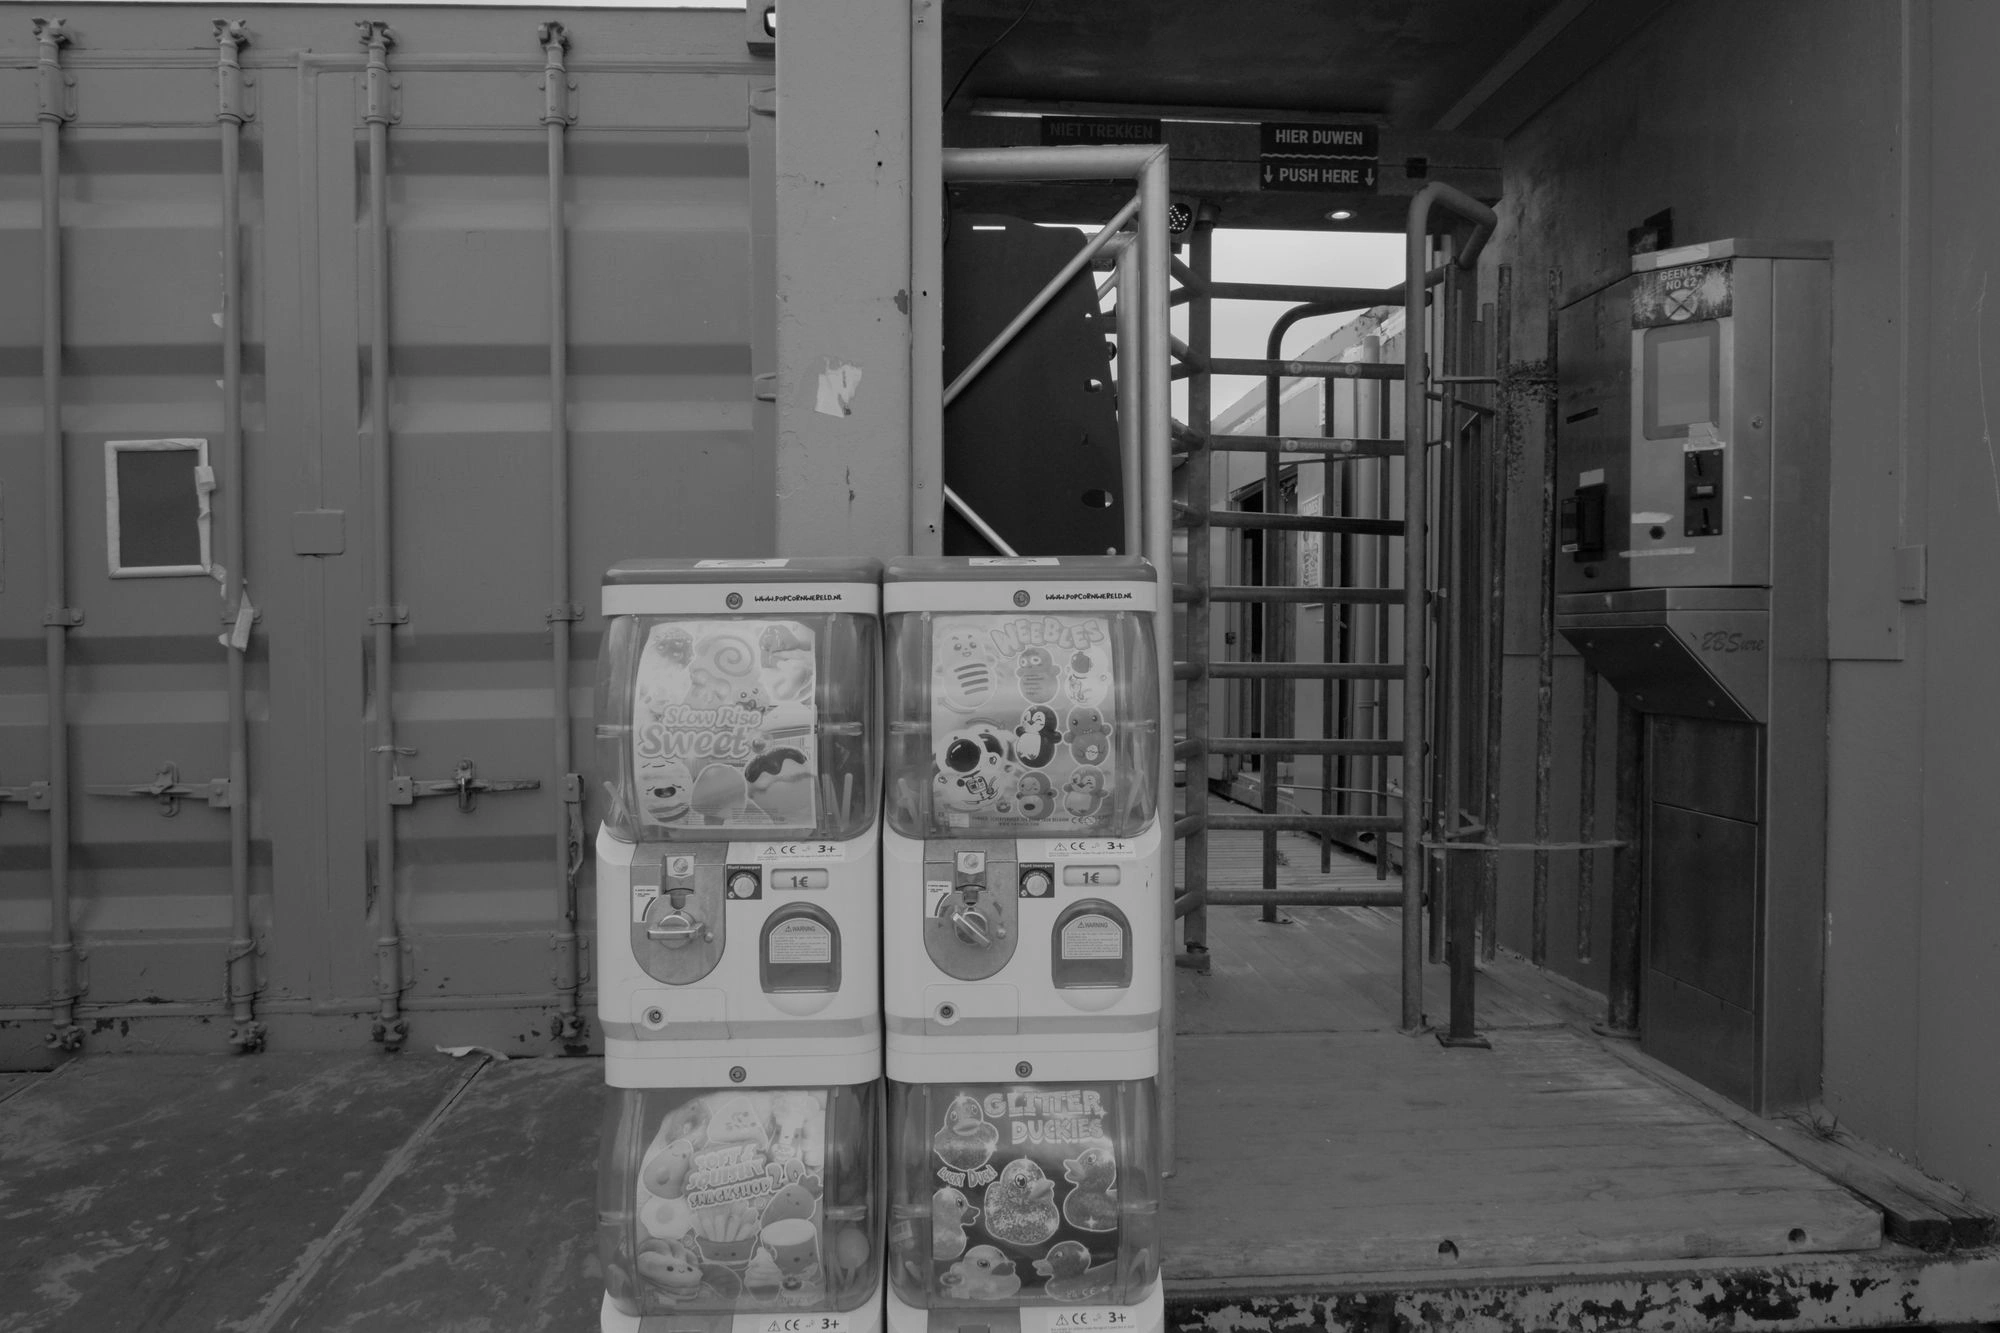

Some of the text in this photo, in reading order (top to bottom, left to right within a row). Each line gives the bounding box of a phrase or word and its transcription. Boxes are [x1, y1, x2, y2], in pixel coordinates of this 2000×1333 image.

[1049, 122, 1153, 139] NIET TREKKEN
[1275, 129, 1363, 145] HIER DUWEN
[1279, 167, 1359, 183] PUSH HERE
[1660, 268, 1688, 281] GEEN
[1666, 280, 1681, 290] NO
[990, 616, 1105, 657] WEEBLES
[716, 705, 761, 727] Rise
[640, 724, 751, 758] Sweet
[818, 844, 836, 853] 3+
[1107, 842, 1125, 850] 3+
[791, 876, 808, 888] 1€
[1083, 872, 1100, 884] 1€
[983, 1089, 1101, 1118] GLITTER
[1011, 1118, 1104, 1145] DUCKIES
[937, 1166, 966, 1188] LUCKY
[821, 1317, 840, 1330] 3+
[1108, 1311, 1127, 1323] 3+
